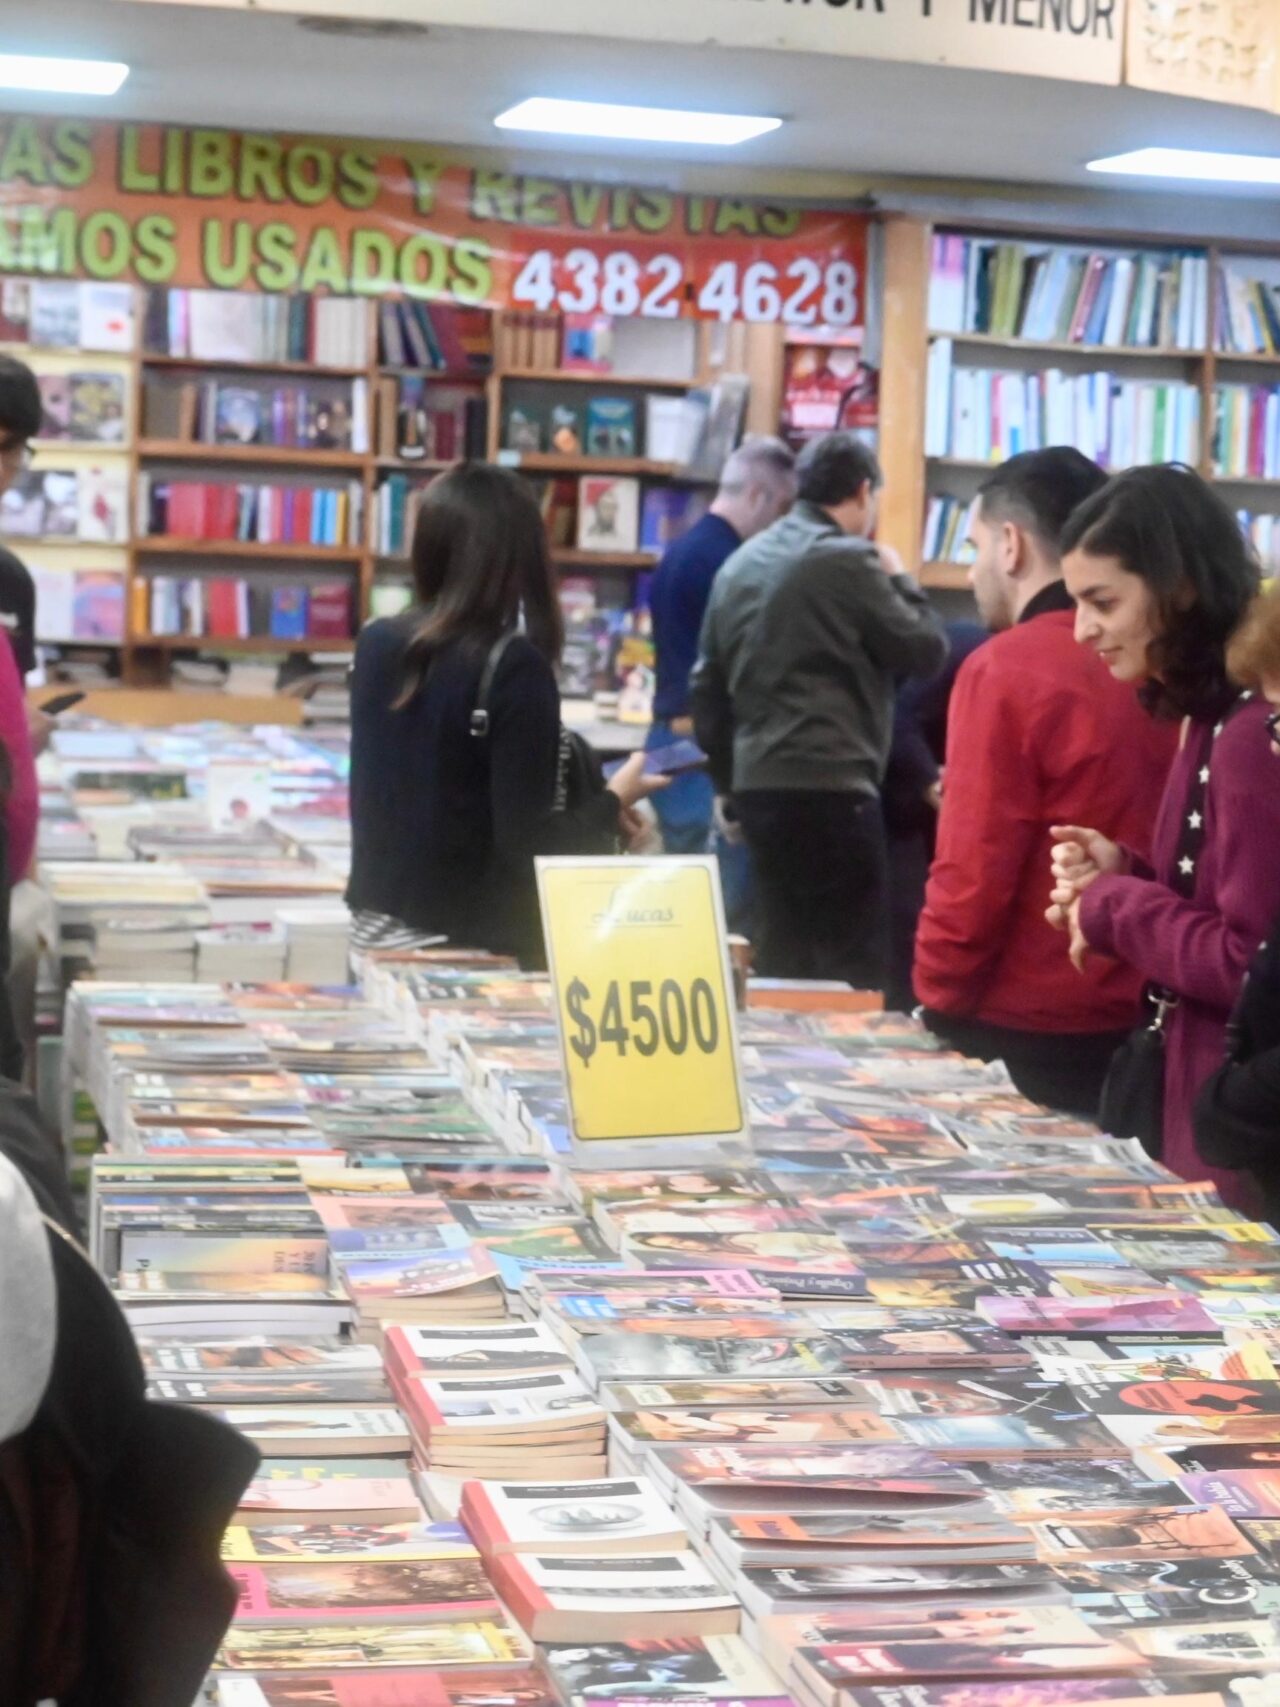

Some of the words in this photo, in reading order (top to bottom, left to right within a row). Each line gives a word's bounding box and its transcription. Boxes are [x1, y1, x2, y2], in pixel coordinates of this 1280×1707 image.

[967, 0, 1114, 41] MENOR
[119, 124, 380, 210] LIBROS
[405, 155, 446, 216] Y
[203, 217, 492, 304] USADOS
[565, 976, 719, 1068] $4500
